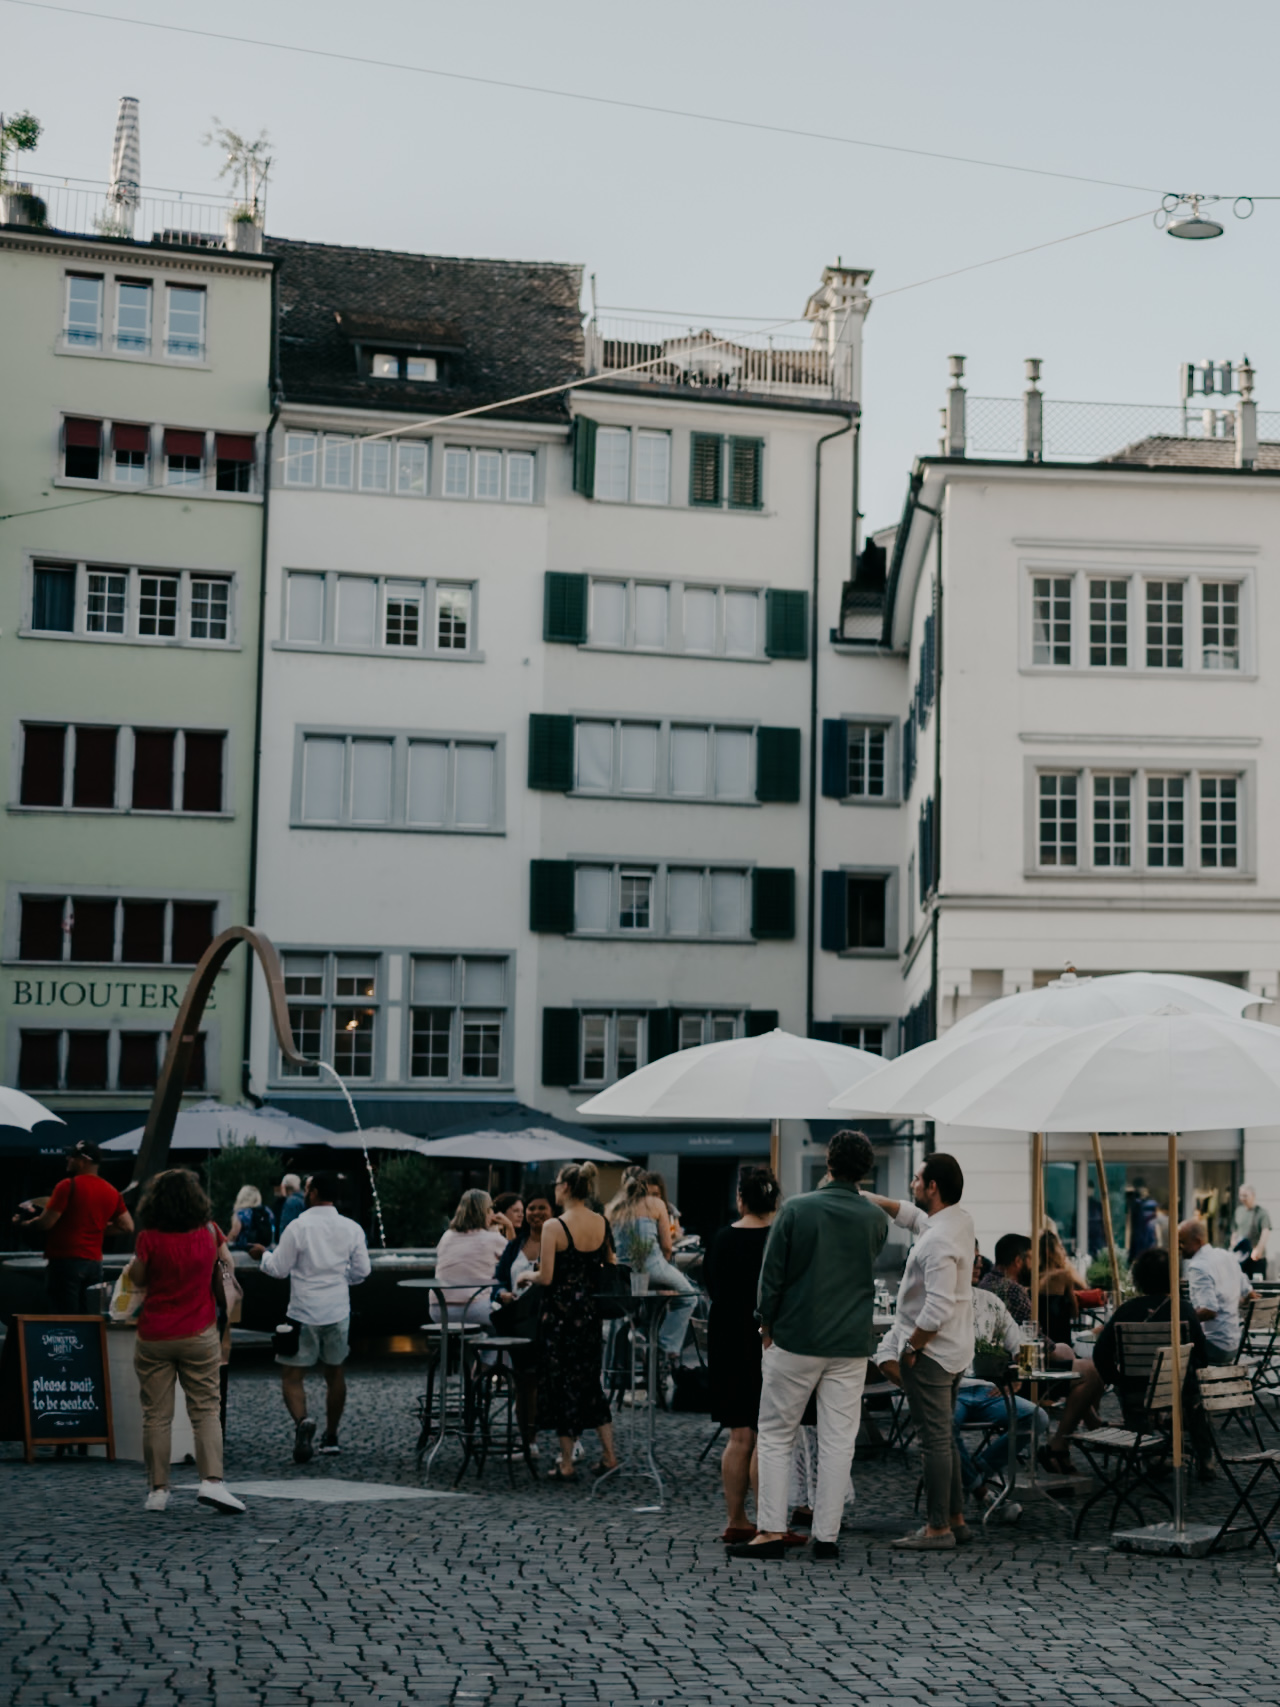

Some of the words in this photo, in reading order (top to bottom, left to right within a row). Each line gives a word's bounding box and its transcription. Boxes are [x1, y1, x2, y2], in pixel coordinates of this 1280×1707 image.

[12, 980, 217, 1010] BIJOUTERE
[33, 1376, 67, 1395] please
[70, 1377, 95, 1392] wait
[33, 1395, 45, 1410] to
[46, 1394, 58, 1410] be
